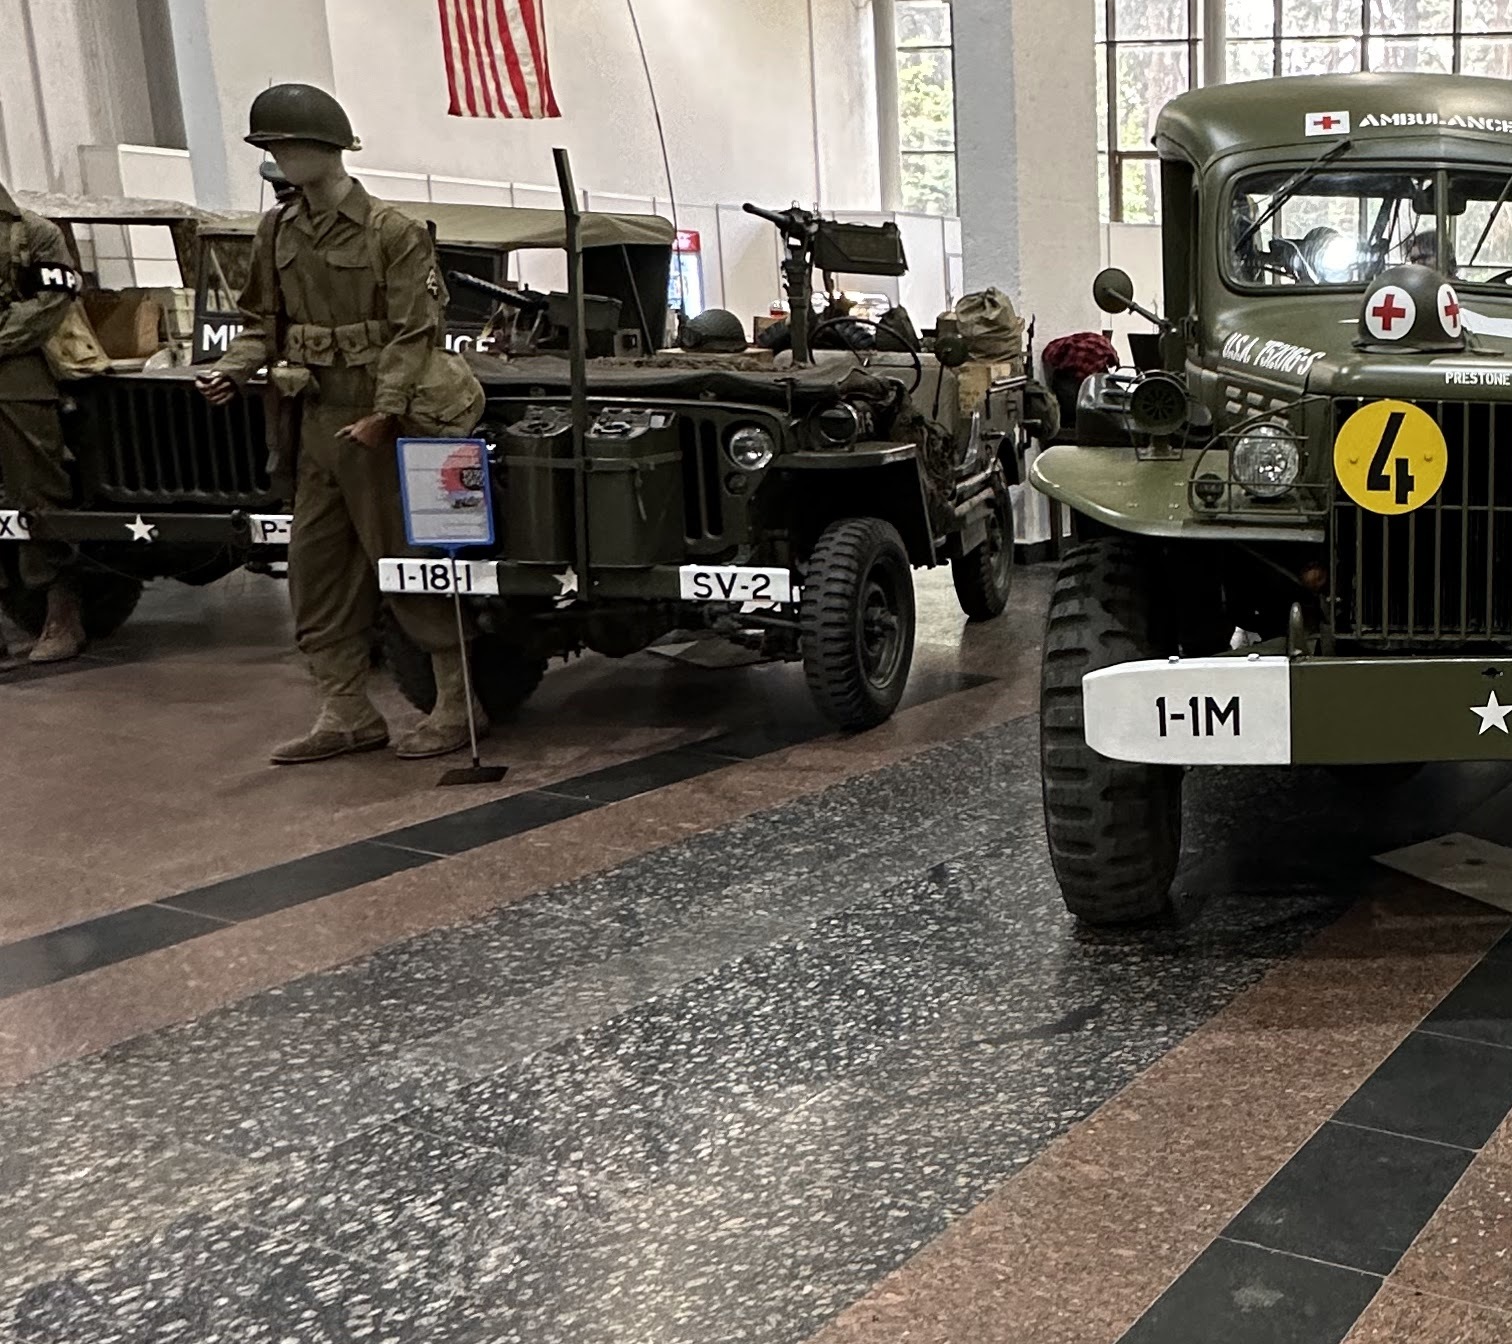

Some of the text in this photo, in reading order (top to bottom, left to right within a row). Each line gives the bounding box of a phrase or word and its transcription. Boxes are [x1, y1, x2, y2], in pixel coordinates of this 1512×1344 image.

[1445, 371, 1511, 386] PRESTONE
[1366, 412, 1415, 505] 4
[396, 563, 472, 592] 1-18-1
[693, 572, 771, 600] SV-2
[1156, 696, 1241, 737] 1-1M
